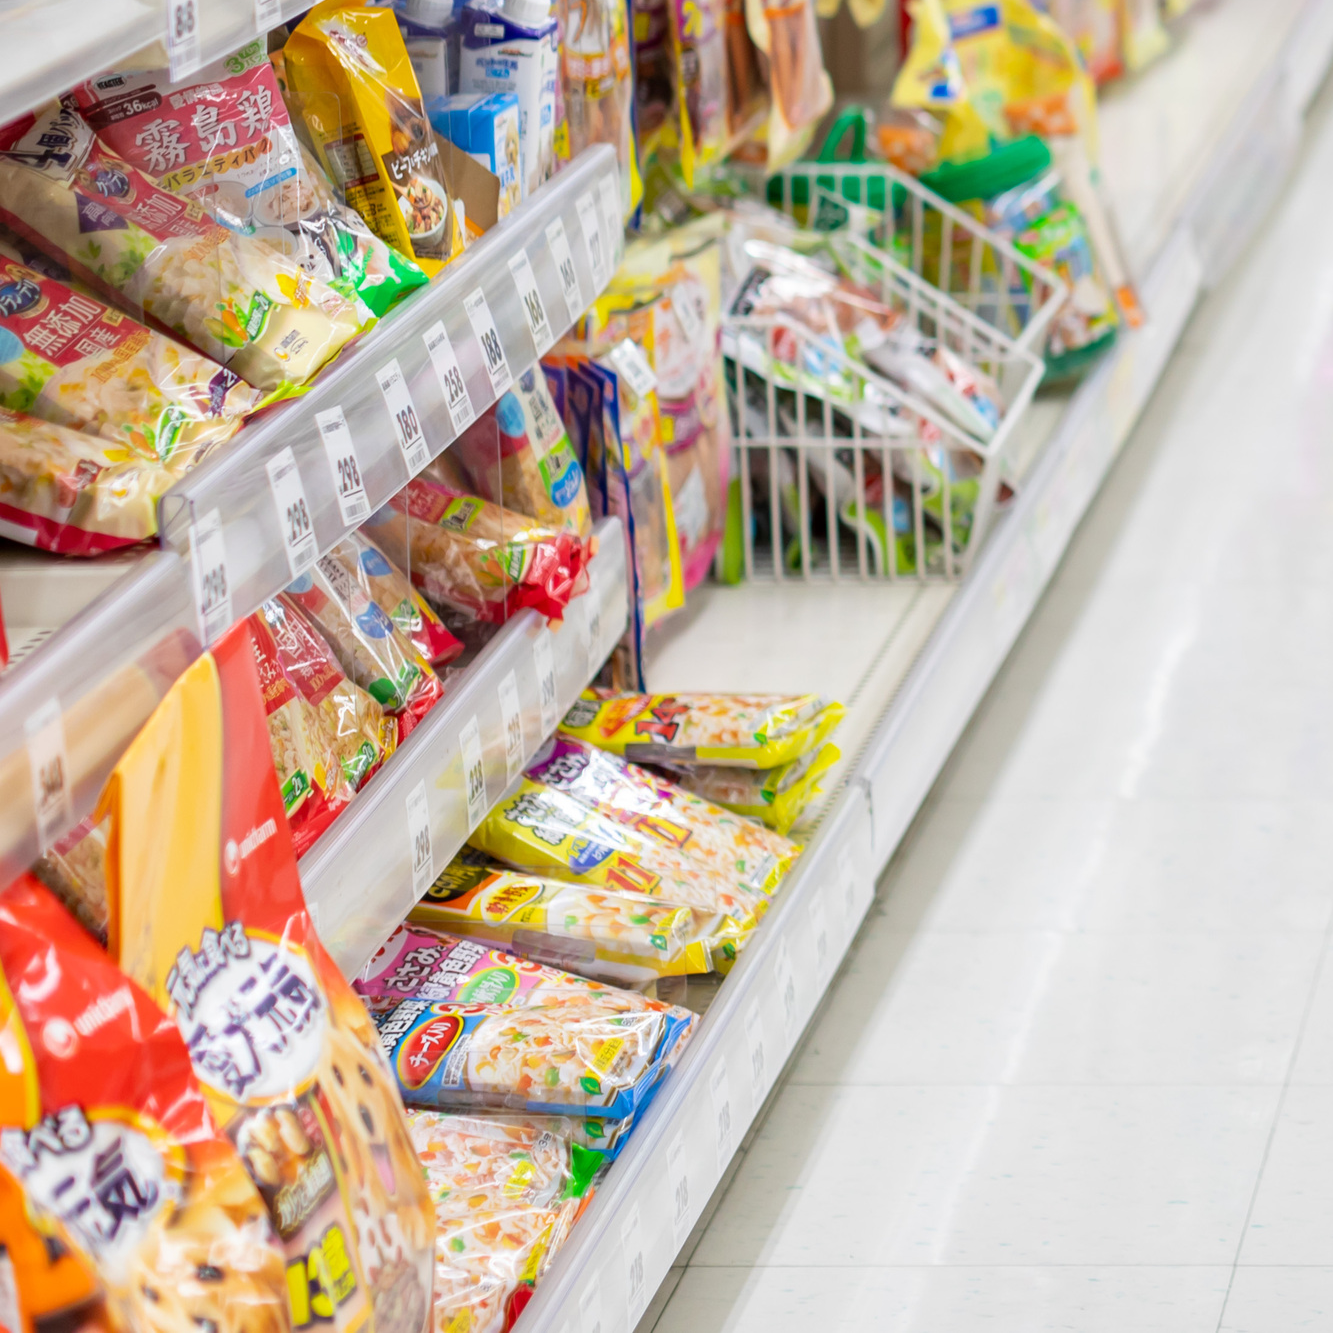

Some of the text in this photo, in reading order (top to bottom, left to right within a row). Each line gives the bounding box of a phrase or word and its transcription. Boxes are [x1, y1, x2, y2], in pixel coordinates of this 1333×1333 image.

[176, 0, 195, 39] 88
[135, 85, 274, 174] 霧島鶏
[481, 328, 502, 367] 188
[444, 366, 465, 405] 258
[399, 410, 419, 447] 180
[409, 1019, 453, 1068] チーズ入り
